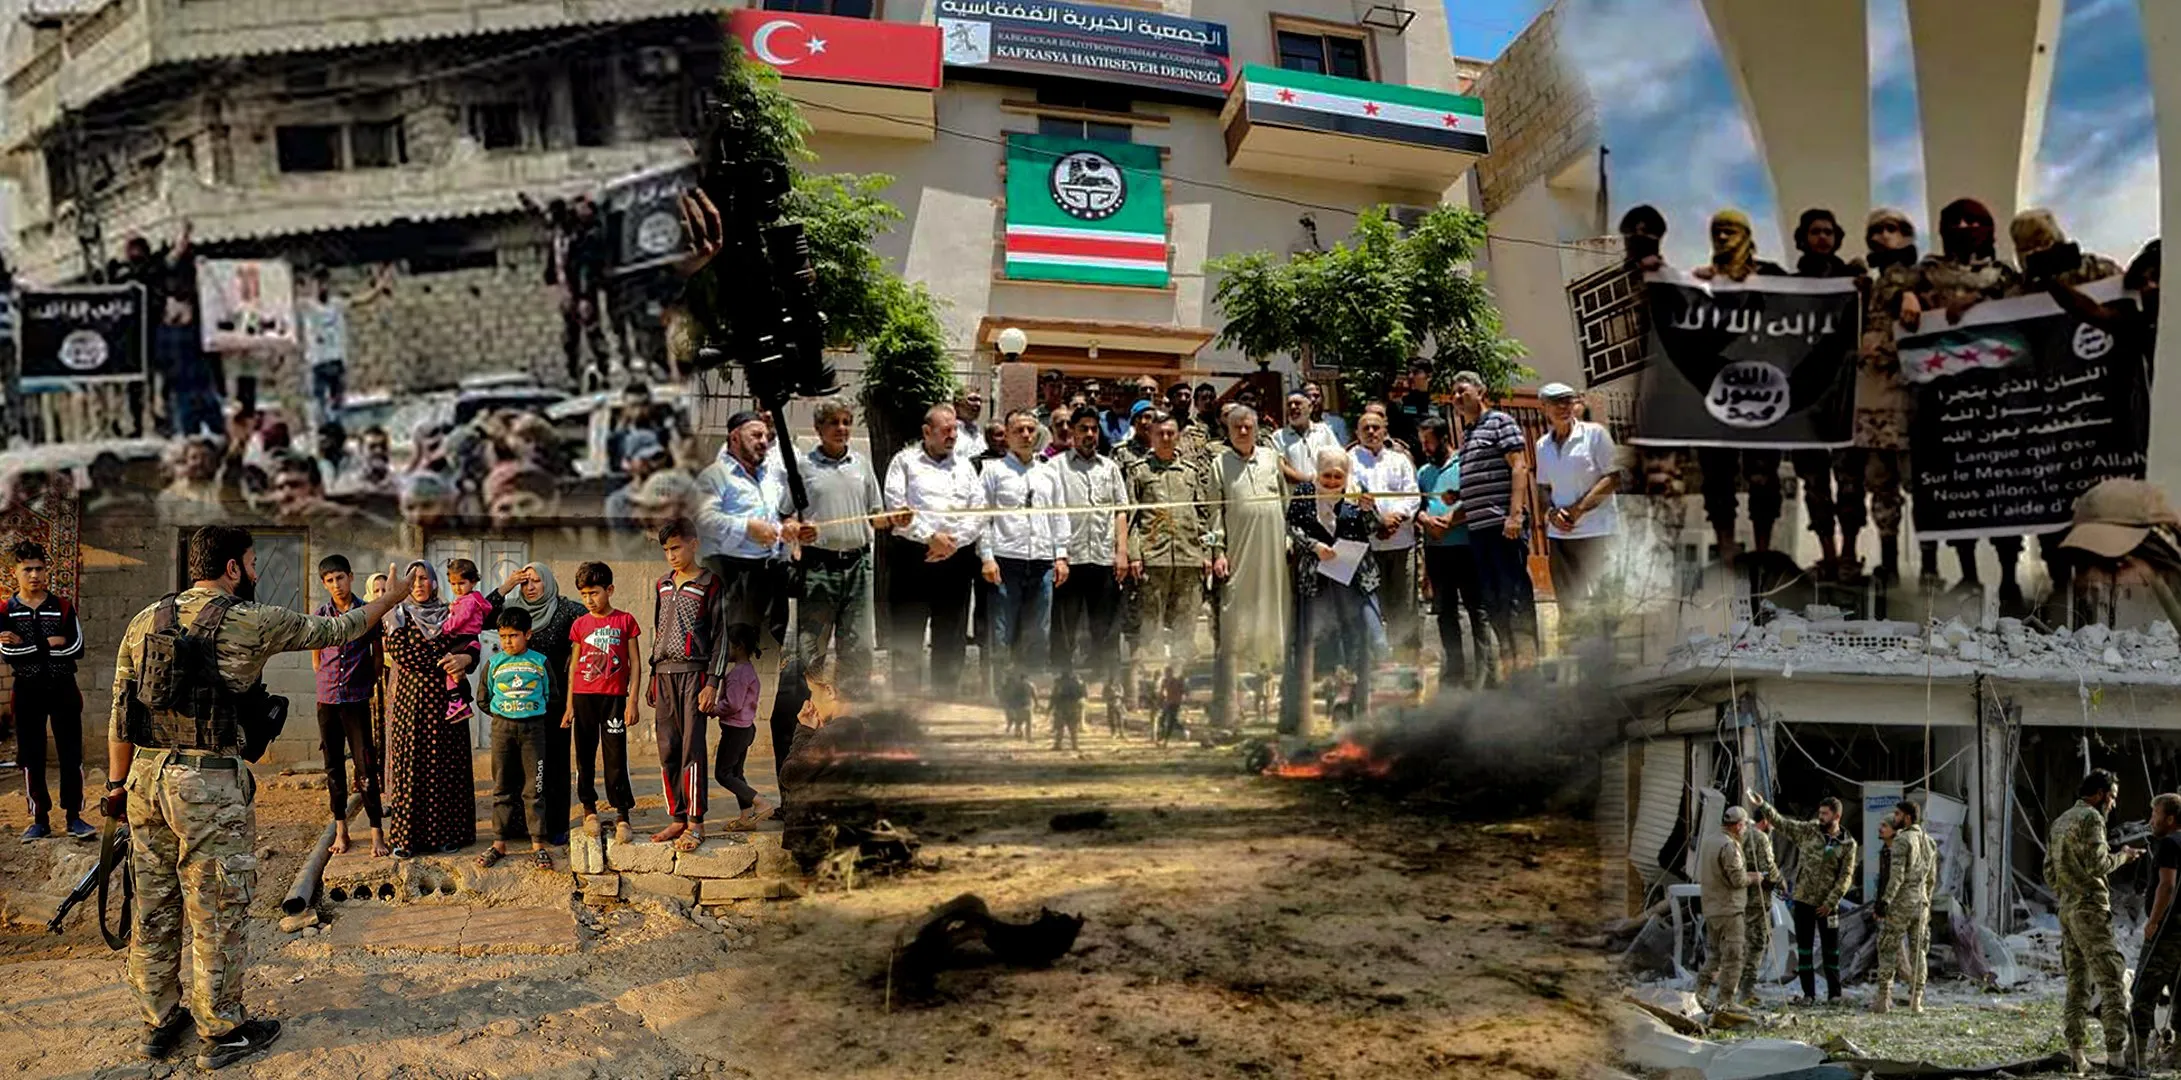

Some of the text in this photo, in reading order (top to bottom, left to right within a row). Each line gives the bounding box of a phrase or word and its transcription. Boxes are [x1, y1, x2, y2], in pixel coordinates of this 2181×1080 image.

[1063, 10, 1133, 33] الخيرية
[1138, 19, 1220, 47] الجمعية
[997, 45, 1068, 63] KAFKASYA
[1071, 53, 1158, 75] HAYIRSEVER
[1940, 407, 1981, 422] الله
[1942, 429, 1973, 444] الله
[1955, 448, 2020, 465] Langue
[2027, 444, 2057, 461] qui
[1921, 471, 1948, 486] Sur
[1953, 469, 1969, 482] le
[1975, 462, 2064, 481] Messager
[1933, 488, 1980, 502] Nous
[1985, 484, 2038, 500] allons
[2041, 480, 2060, 494] le
[1947, 507, 1988, 520] avec
[1992, 500, 2045, 517] l'aide
